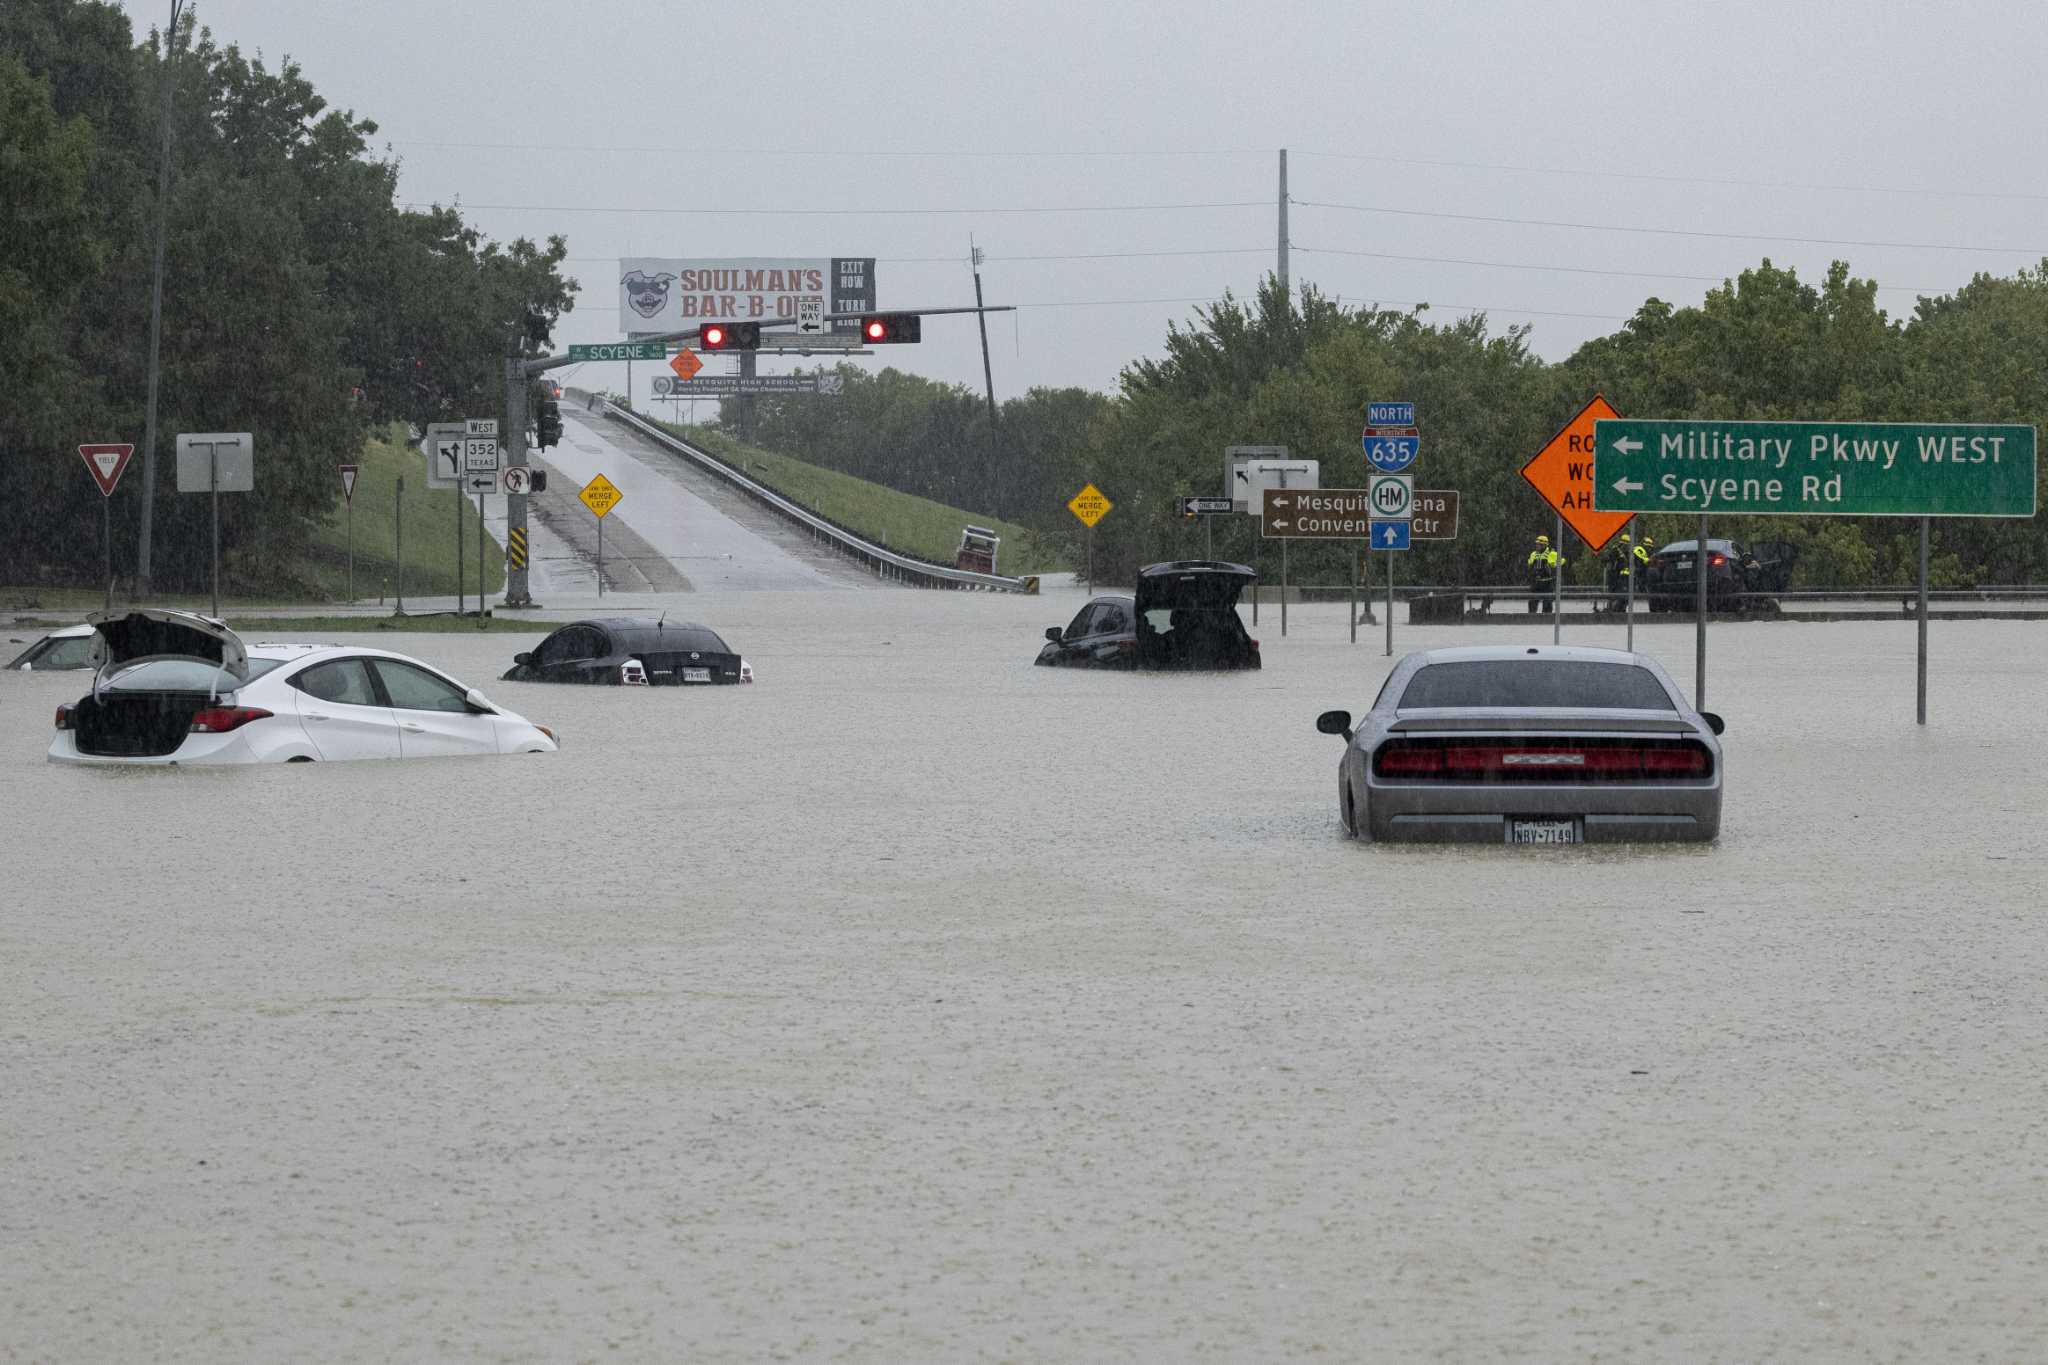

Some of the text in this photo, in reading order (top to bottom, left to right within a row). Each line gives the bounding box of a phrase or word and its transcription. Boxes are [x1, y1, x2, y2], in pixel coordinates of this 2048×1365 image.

[840, 262, 864, 274] EXIT
[681, 269, 823, 291] SOULMAN'S
[840, 276, 864, 288] NOW
[800, 303, 820, 312] ONE
[838, 299, 866, 312] TURN
[800, 312, 820, 321] WAY
[589, 345, 643, 360] SCYENE
[1370, 407, 1412, 421] NORTH
[470, 421, 494, 433] WEST
[469, 443, 495, 455] 352
[1569, 434, 1594, 453] RO
[1372, 441, 1410, 462] 635
[1660, 432, 2006, 469] Military Pkwy WEST
[98, 456, 115, 464] YIELD
[1567, 462, 1594, 481] WO
[588, 492, 612, 500] MERGE
[1378, 487, 1402, 506] HM
[1660, 473, 1842, 507] Scyene Rd
[591, 500, 609, 508] LEFT
[1078, 502, 1104, 510] MERGE
[1297, 495, 1446, 514] Mesquit ena
[1081, 510, 1099, 518] LEFT
[1297, 517, 1440, 533] Conven Ctr
